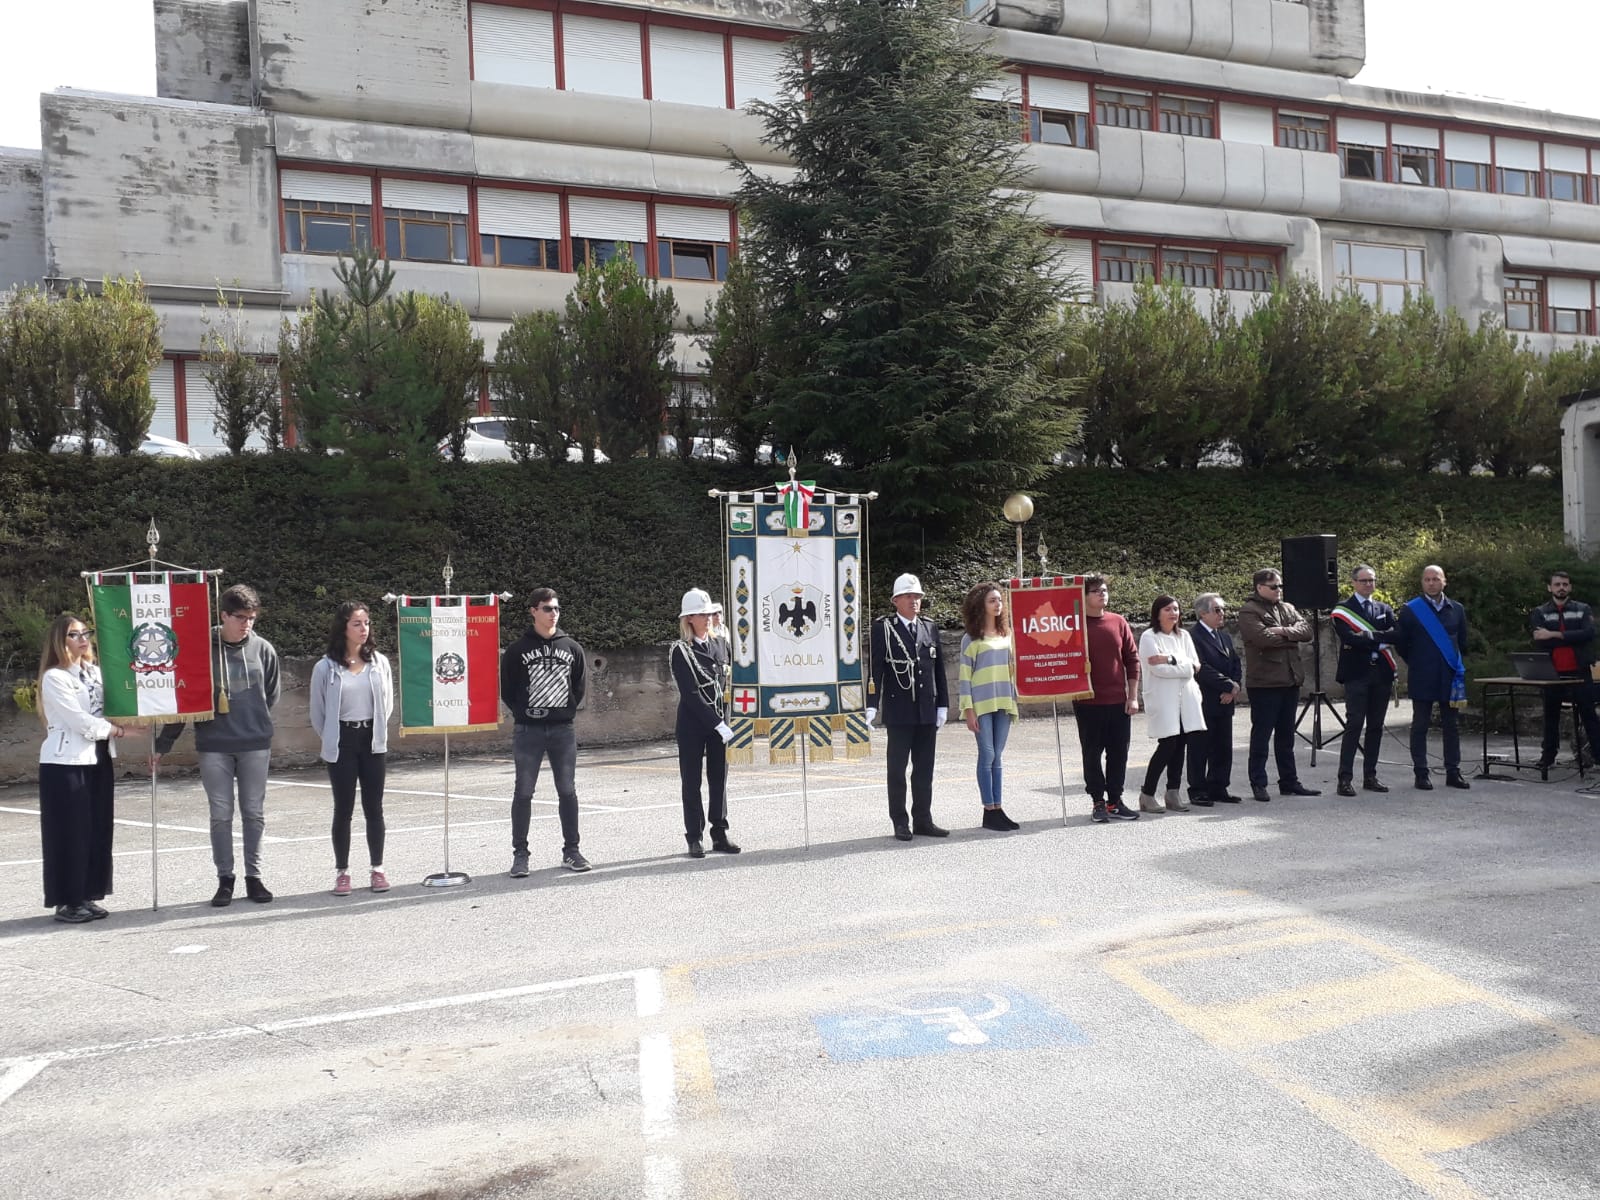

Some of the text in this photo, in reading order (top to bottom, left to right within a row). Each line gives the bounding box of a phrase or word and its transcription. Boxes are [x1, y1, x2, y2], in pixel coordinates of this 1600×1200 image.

[136, 593, 165, 604] I.I.S.
[762, 594, 771, 632] IMMOTA
[823, 594, 831, 629] MANET
[521, 648, 543, 665] JACK
[773, 654, 825, 667] L'AQUILA
[125, 678, 186, 690] L'AQUILA
